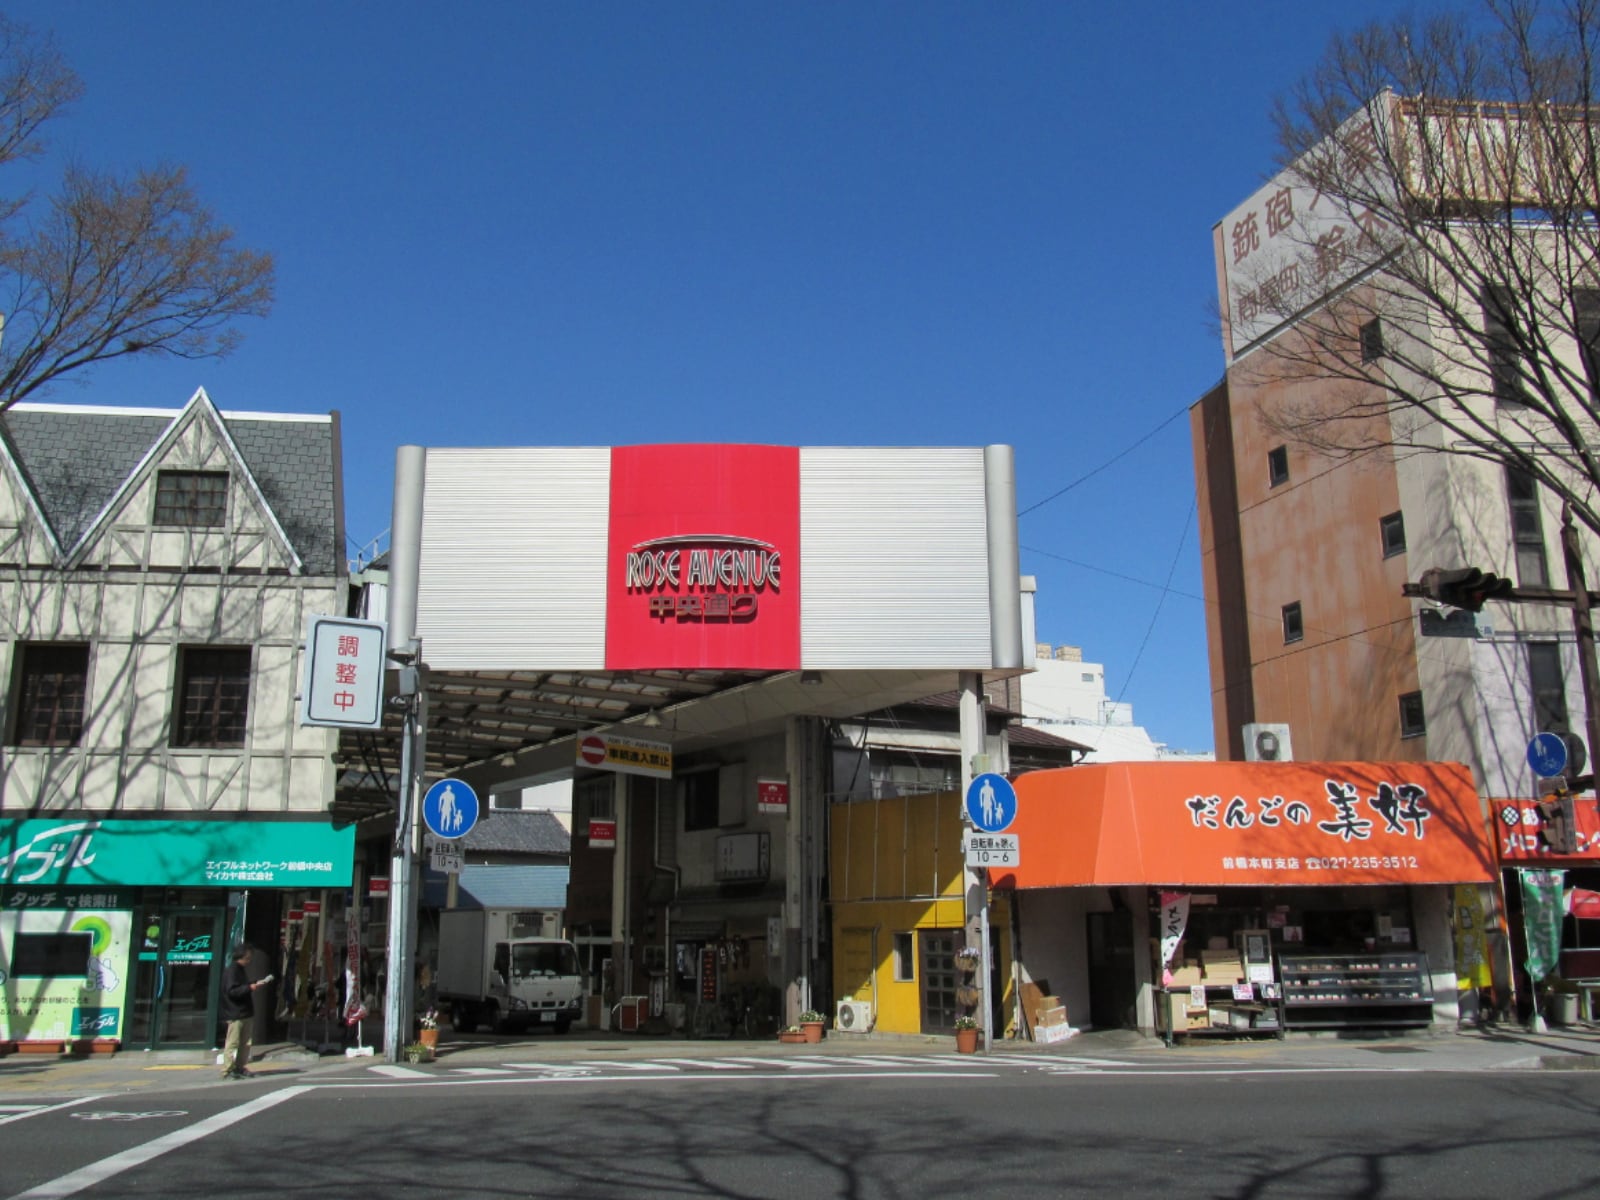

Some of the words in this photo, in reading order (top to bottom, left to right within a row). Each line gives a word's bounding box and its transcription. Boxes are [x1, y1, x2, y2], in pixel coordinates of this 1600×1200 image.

[626, 550, 680, 587] ROSE
[687, 550, 780, 587] AVENUE
[650, 594, 758, 617] 中央通り
[334, 635, 359, 712] 調整中
[1222, 857, 1299, 869] 前橋本町支店
[76, 1013, 116, 1030] エイブル
